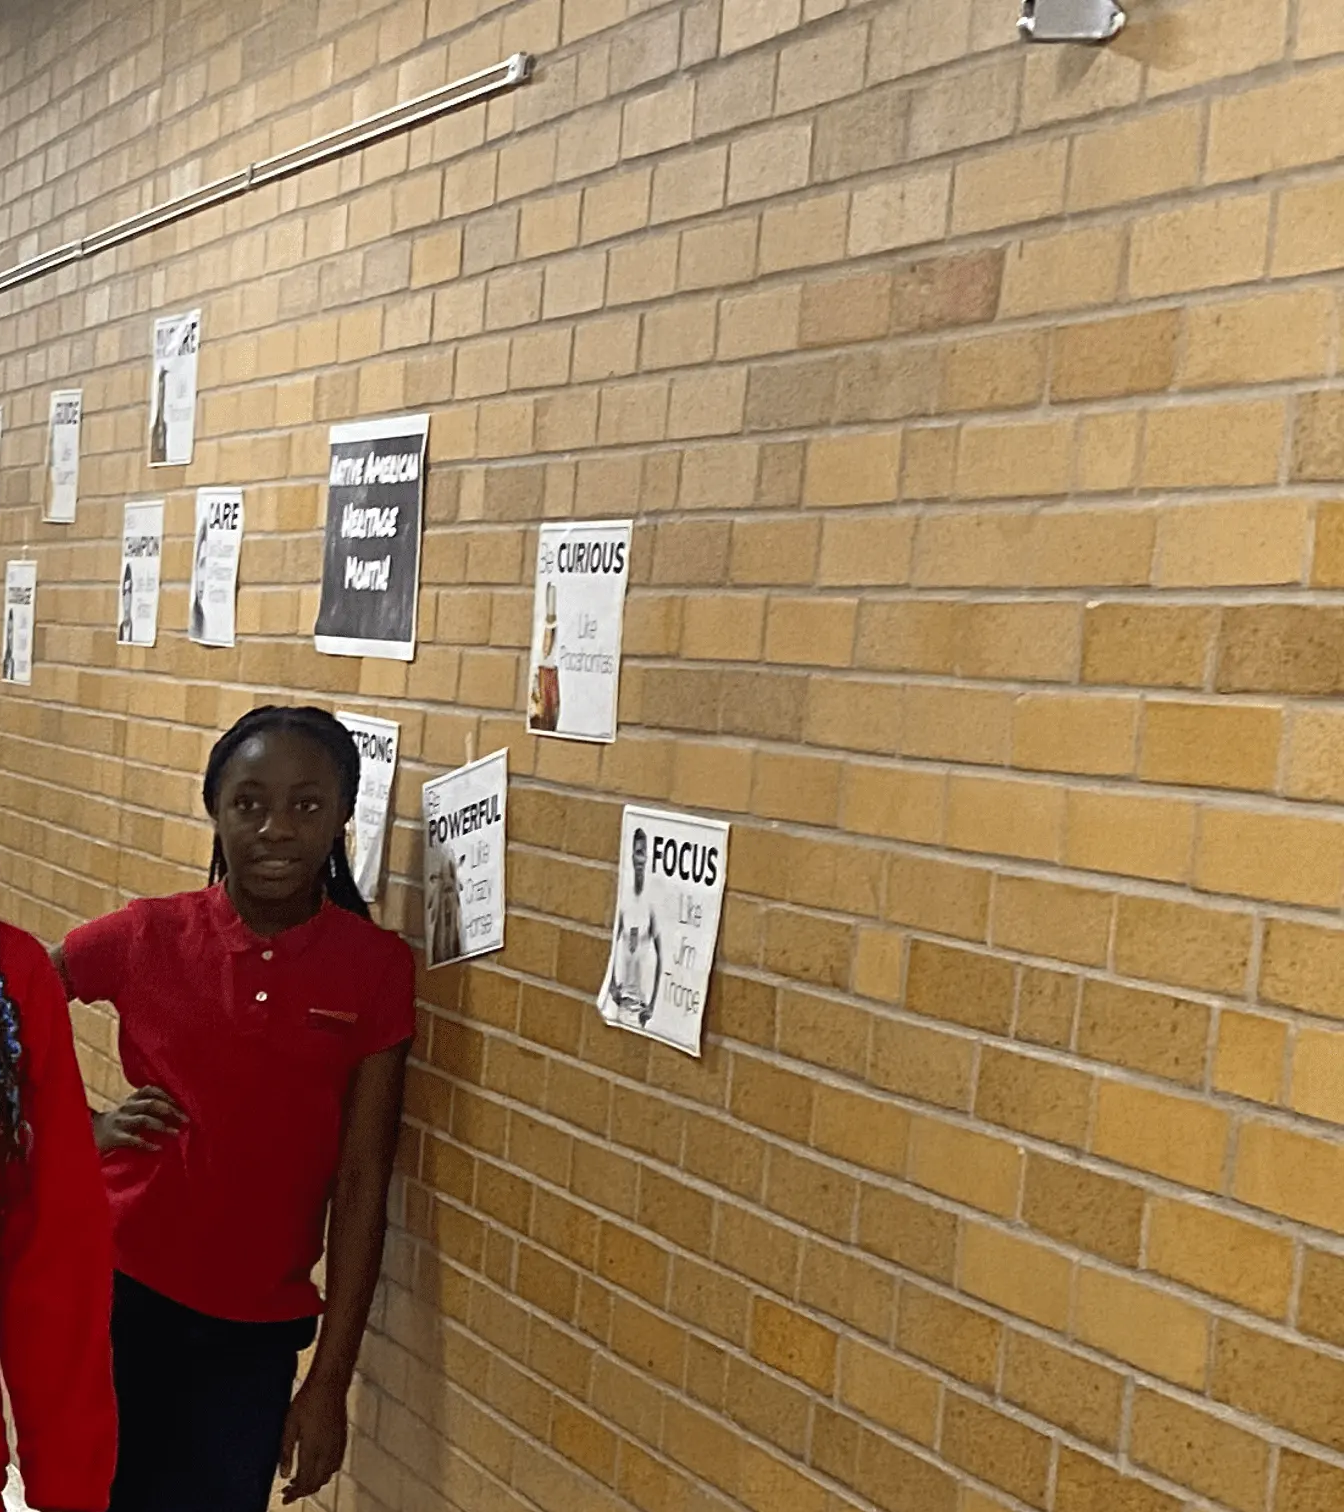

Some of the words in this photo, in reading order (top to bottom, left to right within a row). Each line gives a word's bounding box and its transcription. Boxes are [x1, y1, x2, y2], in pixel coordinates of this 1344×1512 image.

[557, 541, 627, 575] CURIOUS
[428, 793, 502, 848] POWERFUL
[651, 835, 719, 887] FOCUS
[678, 891, 703, 929] Like
